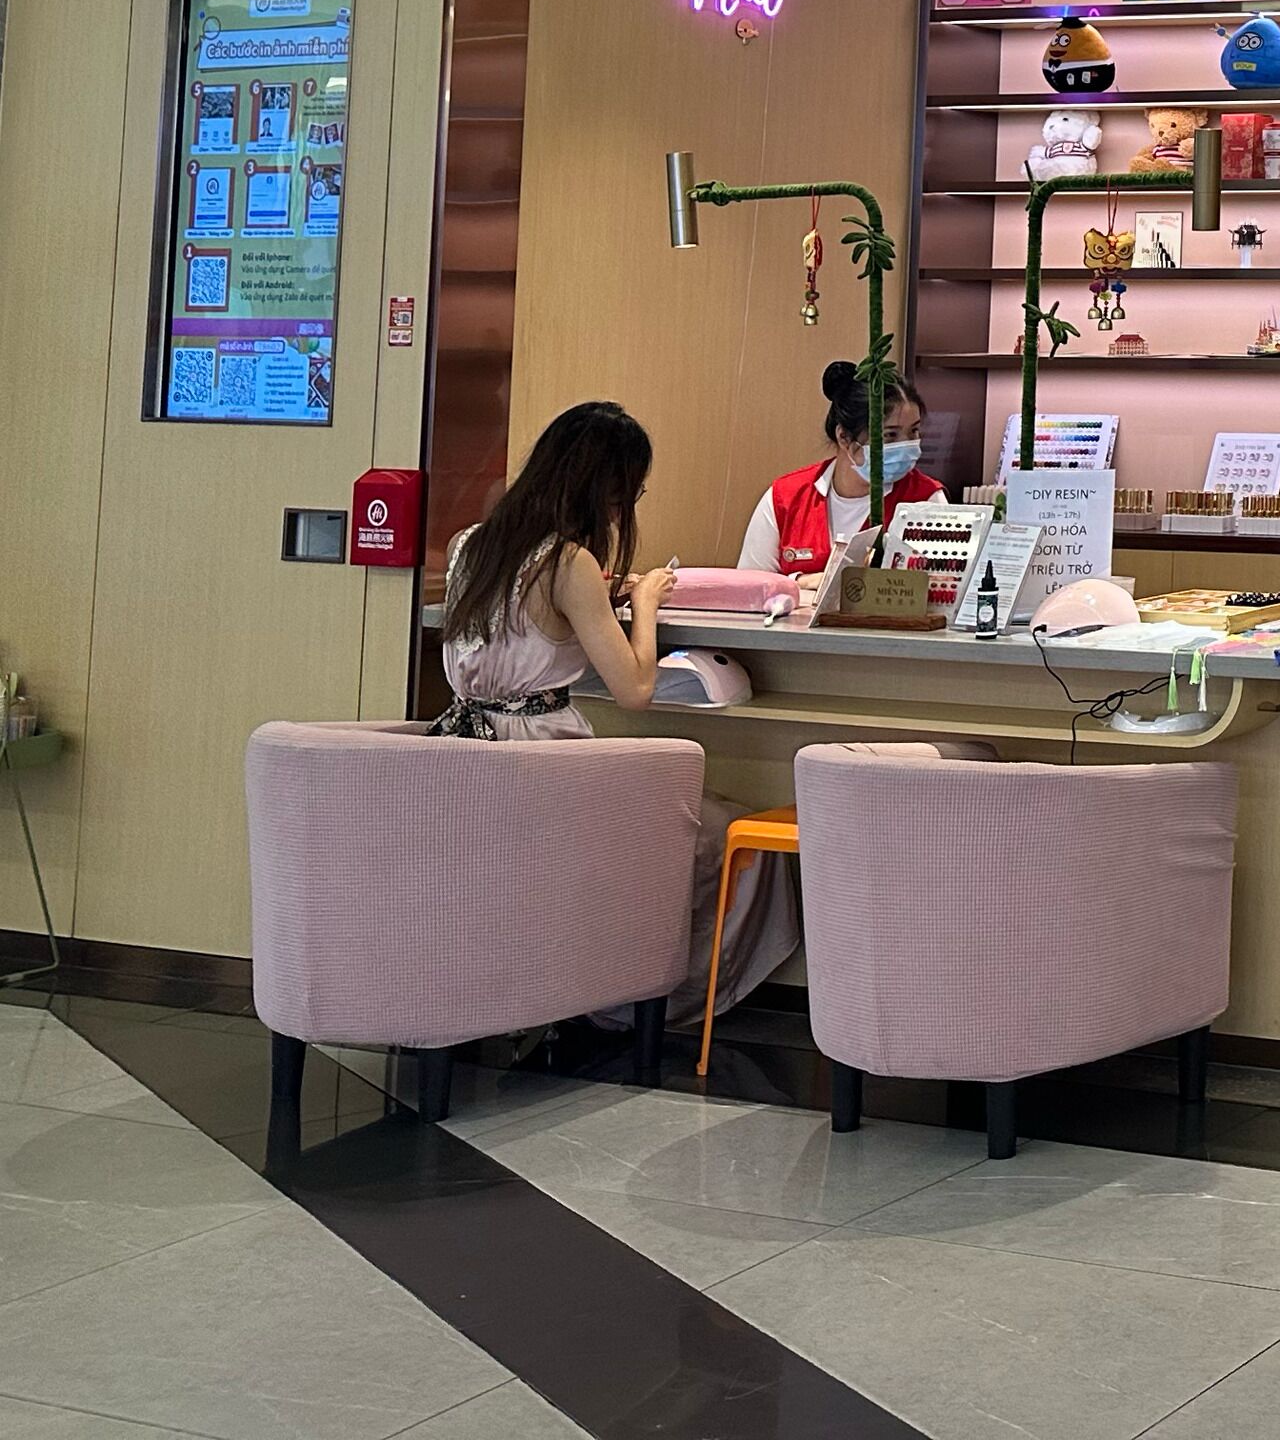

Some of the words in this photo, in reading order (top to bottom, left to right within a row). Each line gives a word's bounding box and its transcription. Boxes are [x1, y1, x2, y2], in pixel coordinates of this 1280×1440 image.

[207, 39, 228, 58] Các
[230, 39, 258, 58] bước
[260, 42, 271, 56] in
[274, 40, 295, 56] ảnh
[298, 36, 328, 55] miễn
[194, 83, 201, 96] 5
[252, 82, 260, 94] 6
[306, 82, 313, 93] 7
[190, 162, 197, 174] 2
[246, 162, 254, 174] 3
[185, 246, 193, 257] 1
[1061, 522, 1087, 536] HÓA
[1068, 560, 1093, 575] TRỞ
